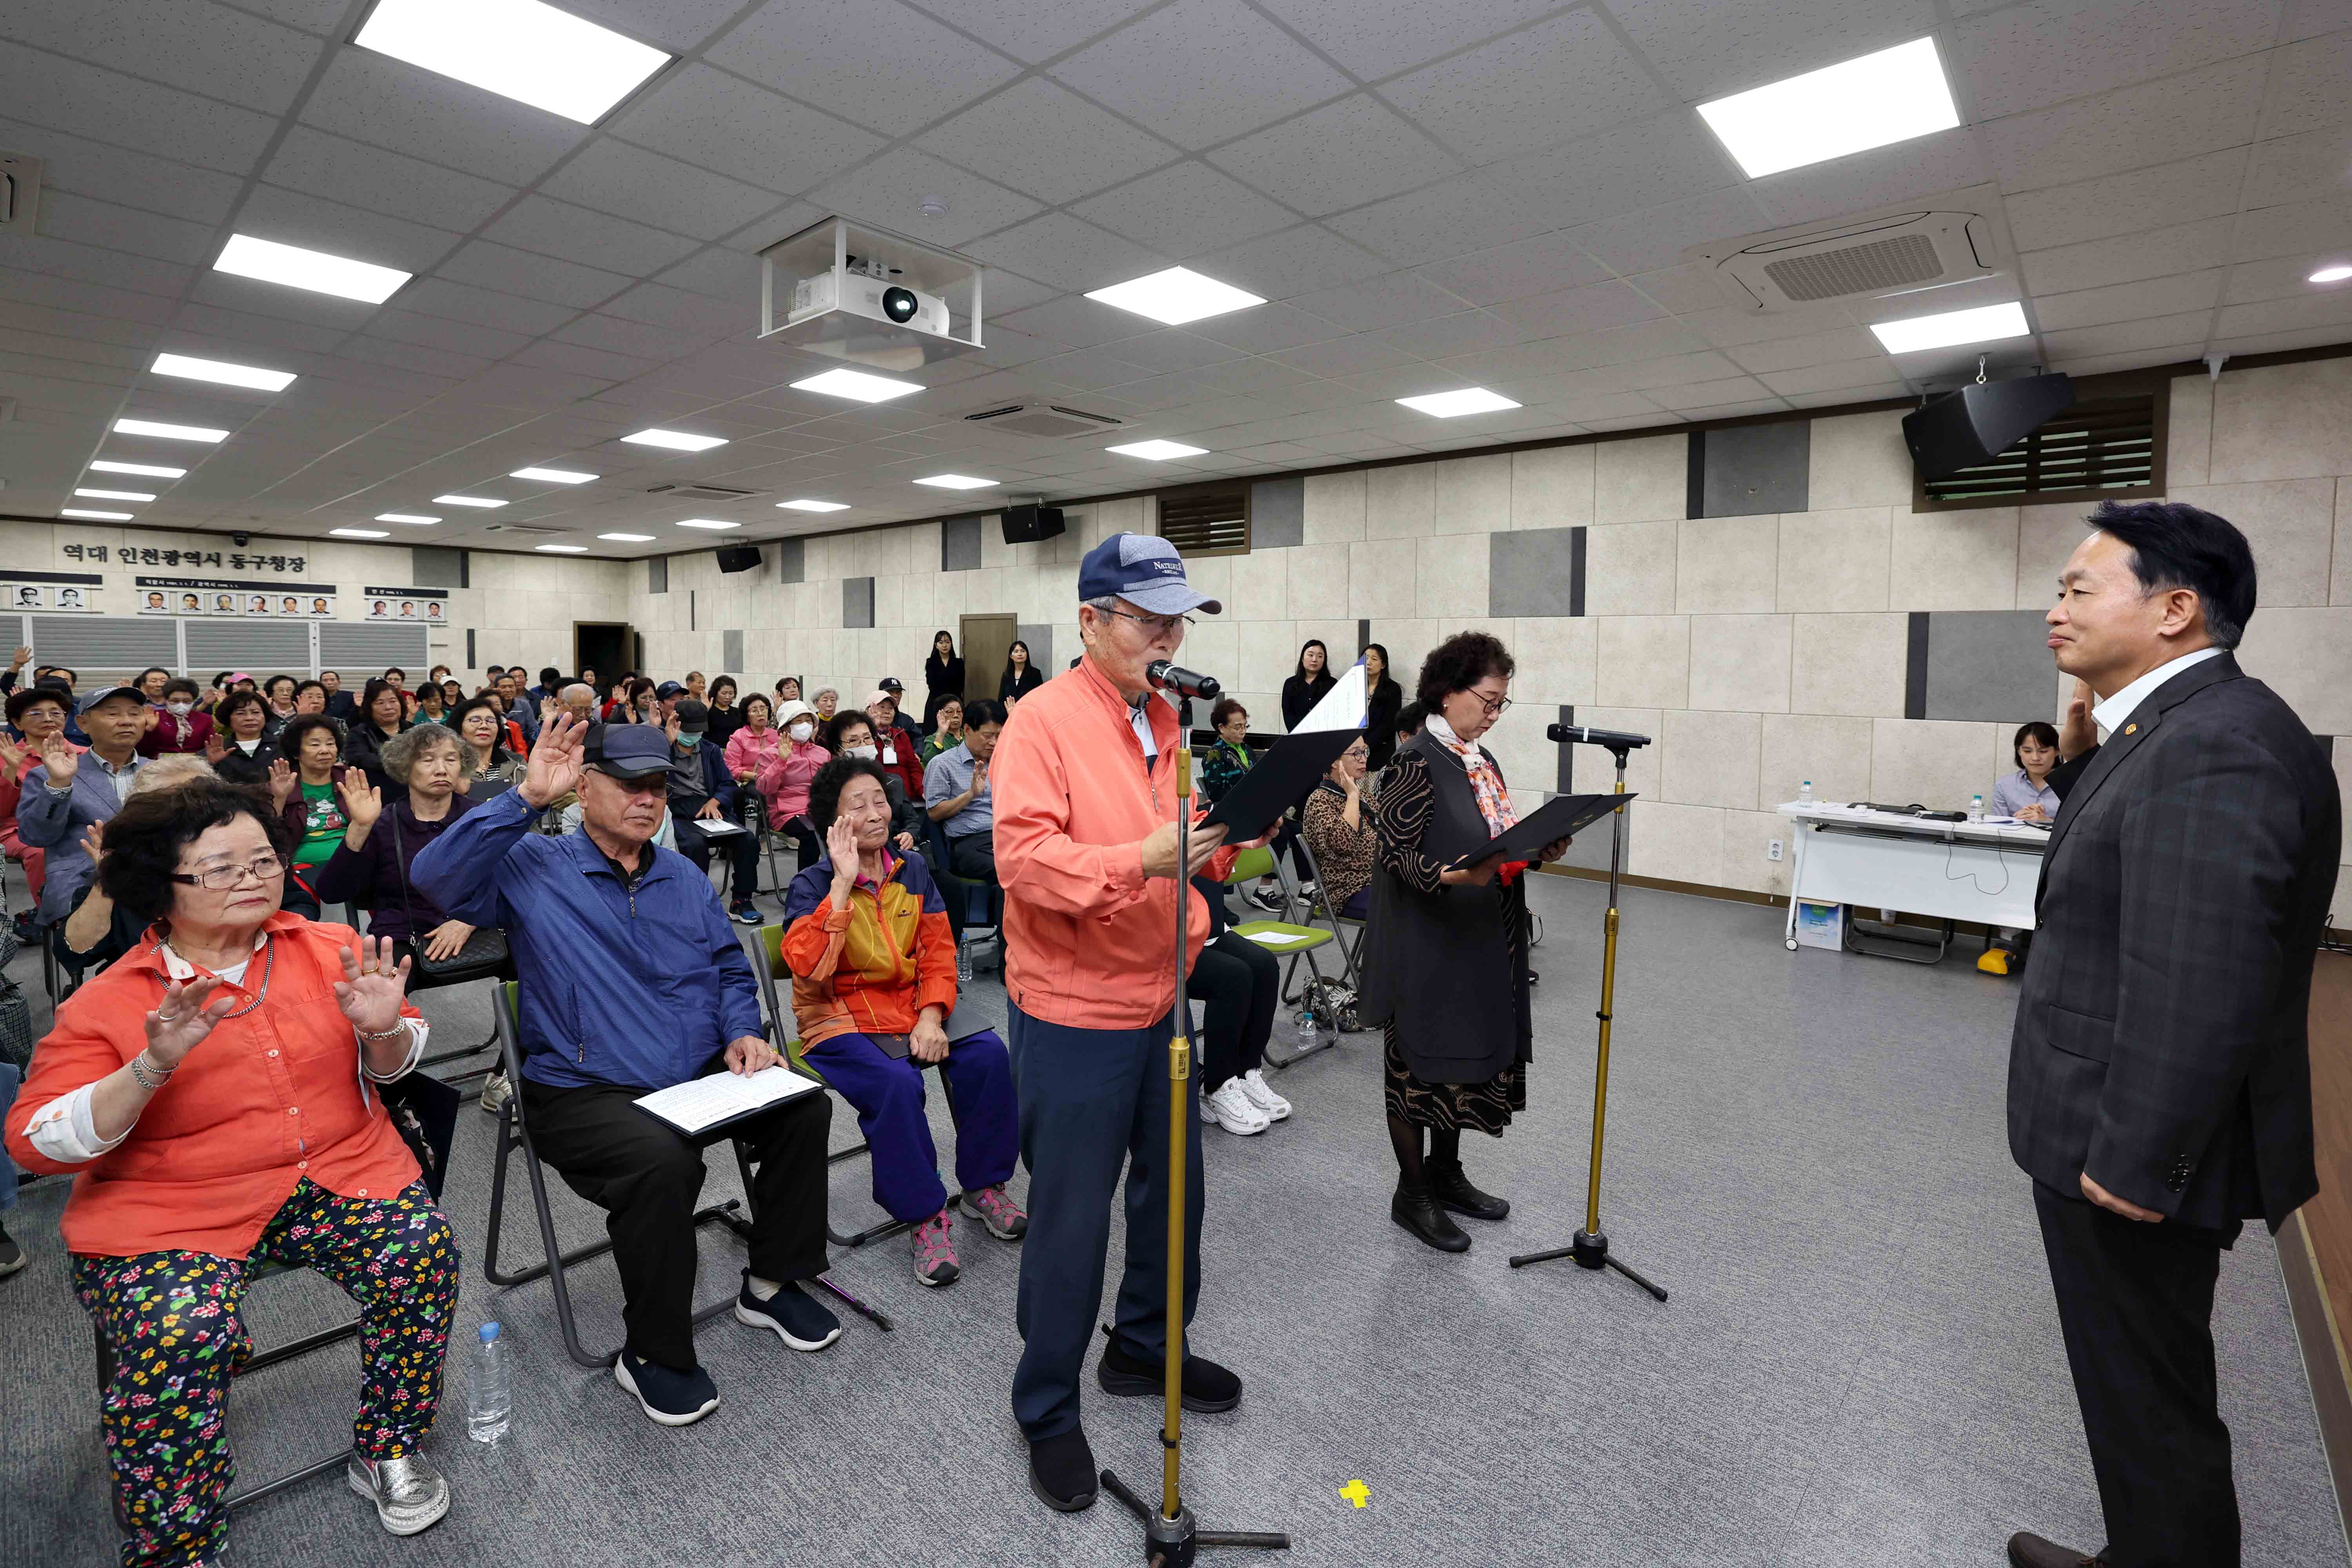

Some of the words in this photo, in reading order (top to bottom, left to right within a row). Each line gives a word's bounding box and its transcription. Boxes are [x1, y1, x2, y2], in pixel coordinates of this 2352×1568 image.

[64, 544, 107, 563] 역대
[118, 547, 220, 567] 인천광역시
[229, 554, 307, 573] 동구청장
